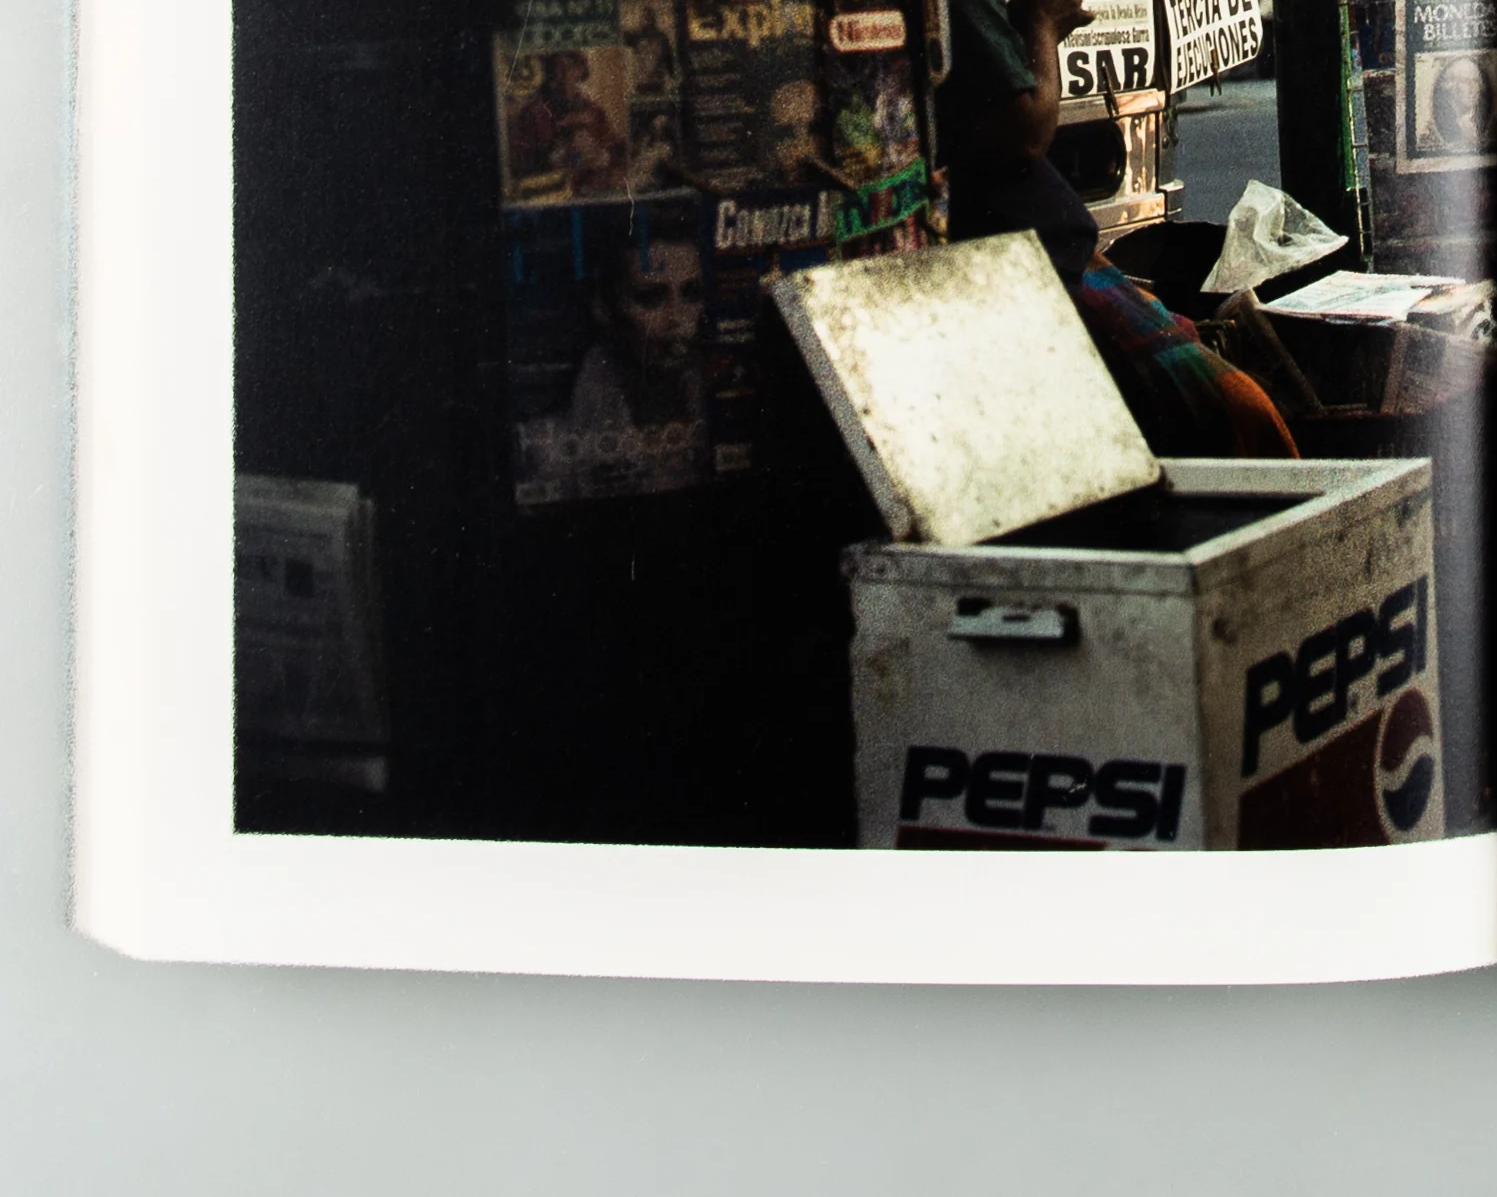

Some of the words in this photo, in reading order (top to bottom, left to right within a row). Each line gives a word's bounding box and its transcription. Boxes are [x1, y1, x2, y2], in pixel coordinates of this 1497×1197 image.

[1066, 47, 1149, 96] SAR
[1176, 17, 1260, 90] EJECUCIONES
[1241, 574, 1427, 778] PEPSI
[901, 745, 1187, 842] PEPSI
